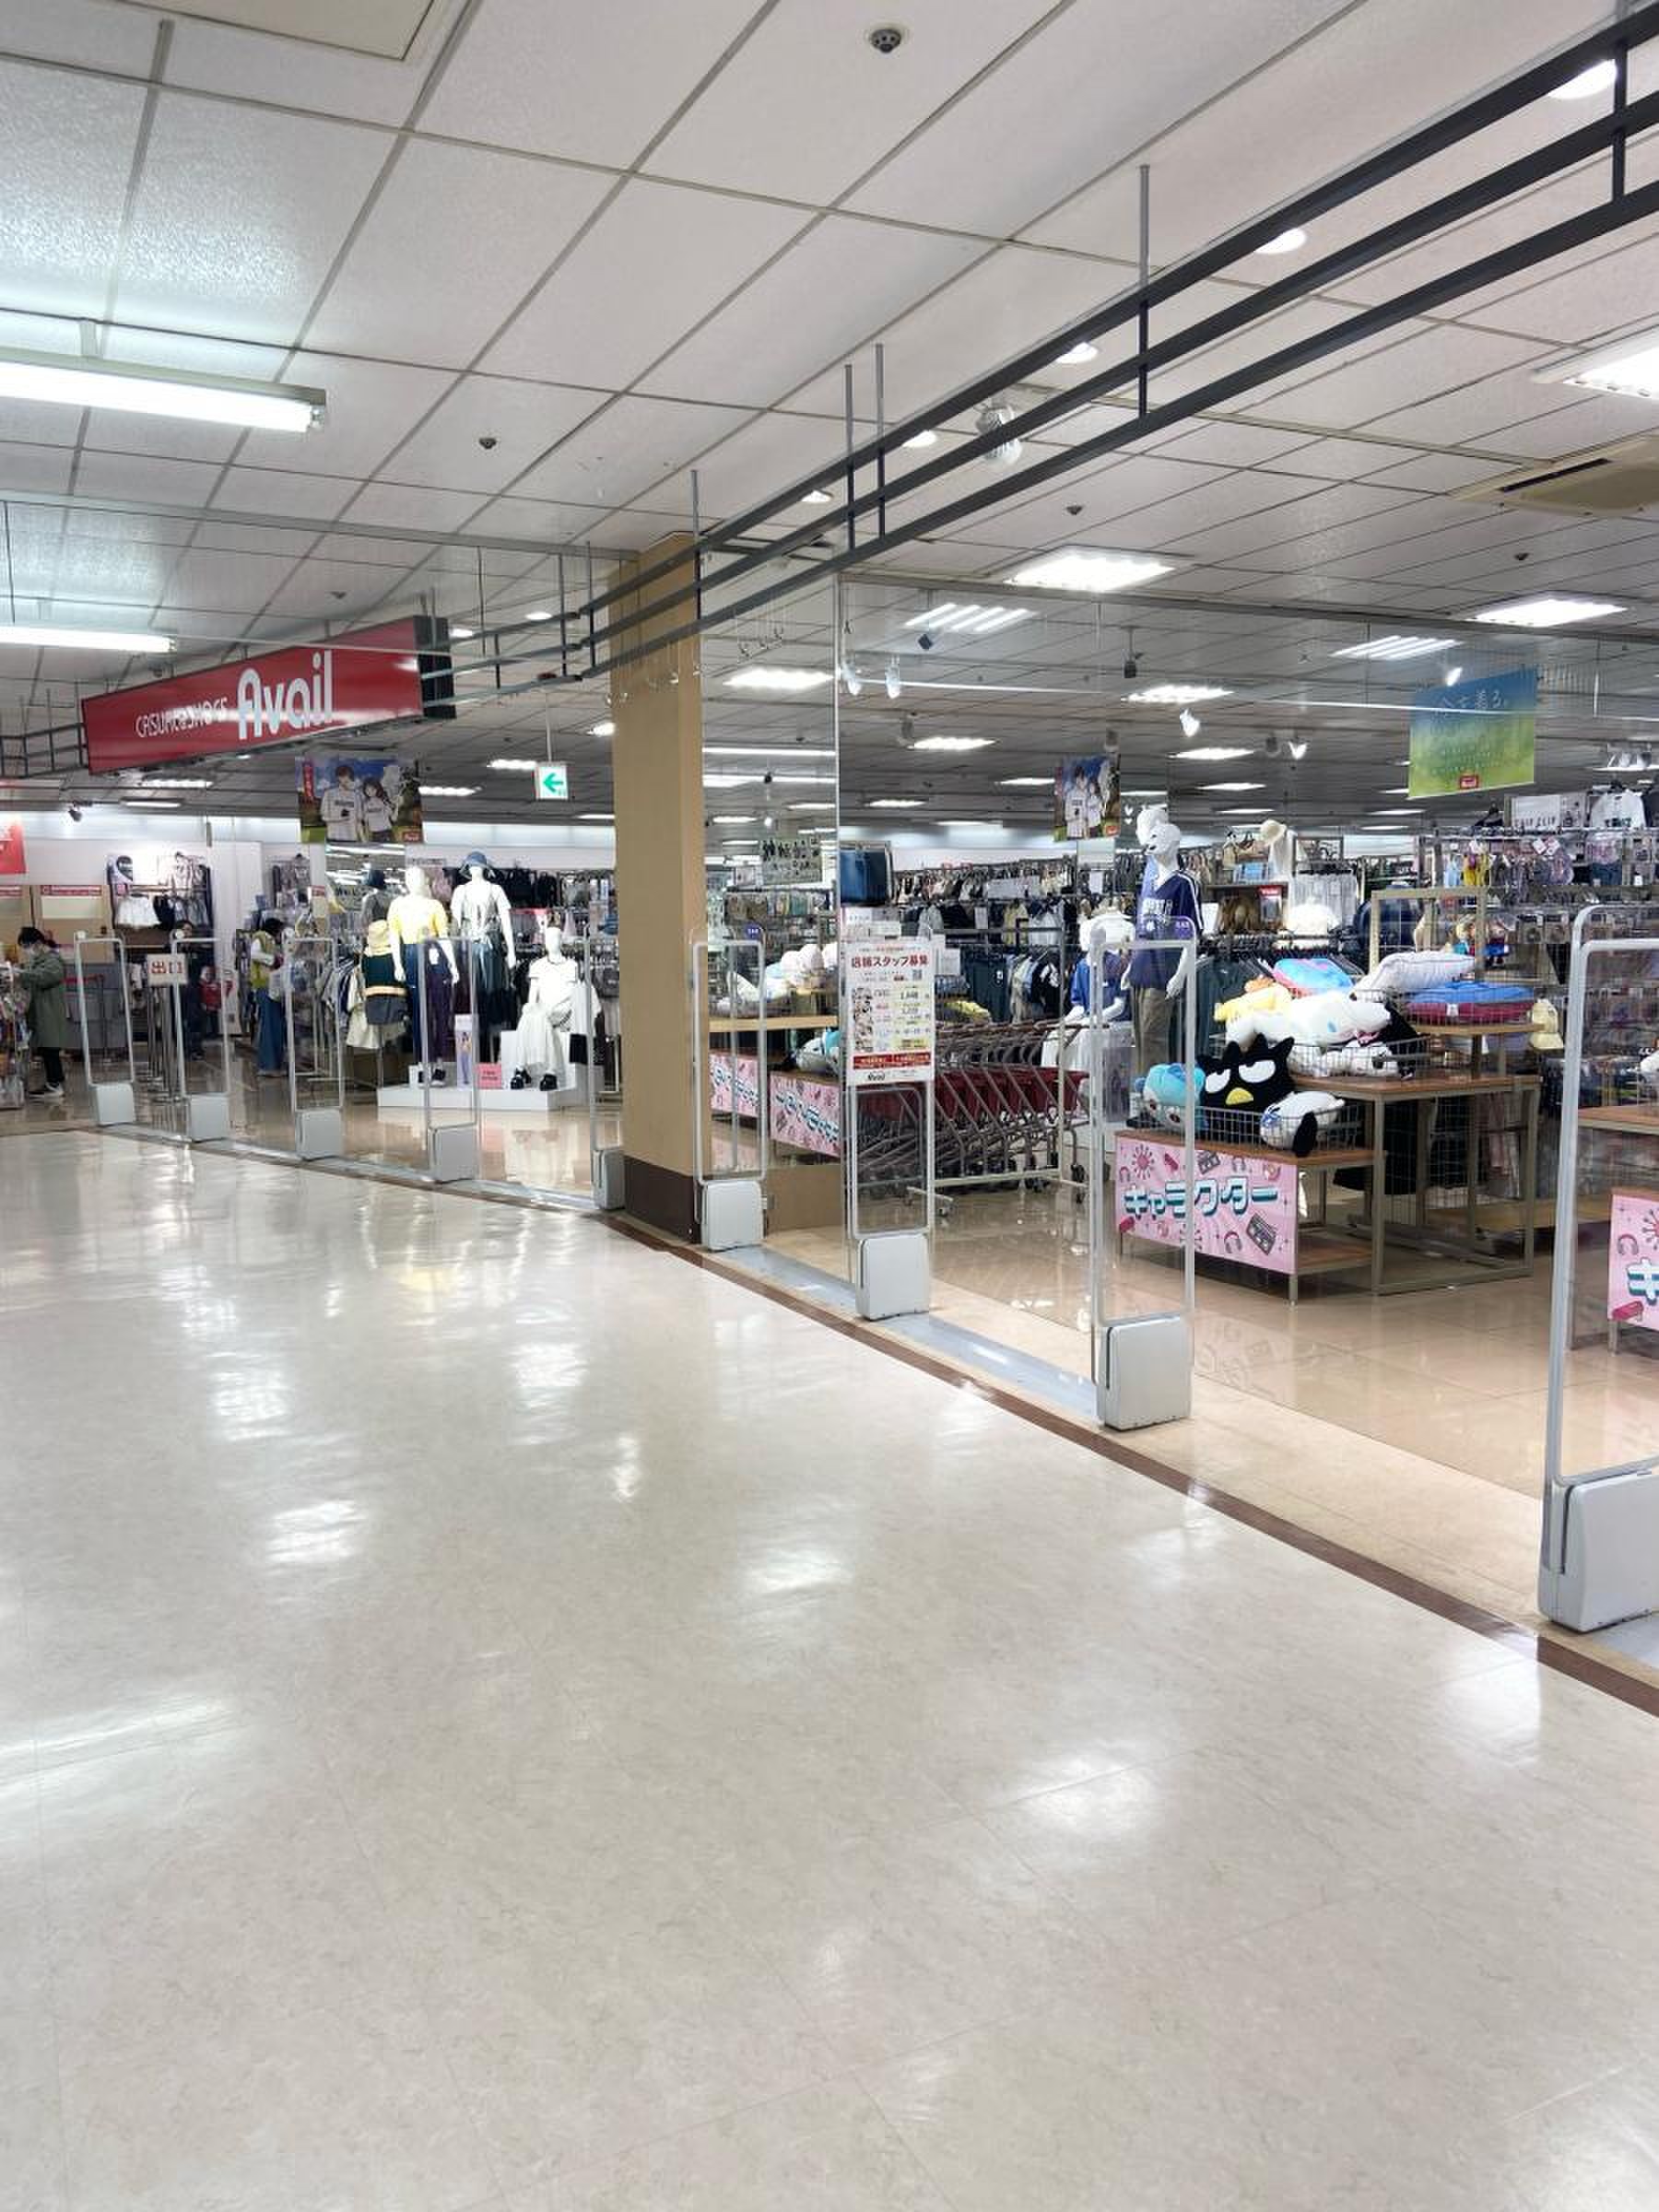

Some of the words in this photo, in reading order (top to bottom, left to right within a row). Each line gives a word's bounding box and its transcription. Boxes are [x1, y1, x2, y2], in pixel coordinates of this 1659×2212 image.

[237, 649, 333, 740] Avail
[851, 954, 928, 968] 店舗スタッフ募集
[1123, 1176, 1278, 1221] キャラクター
